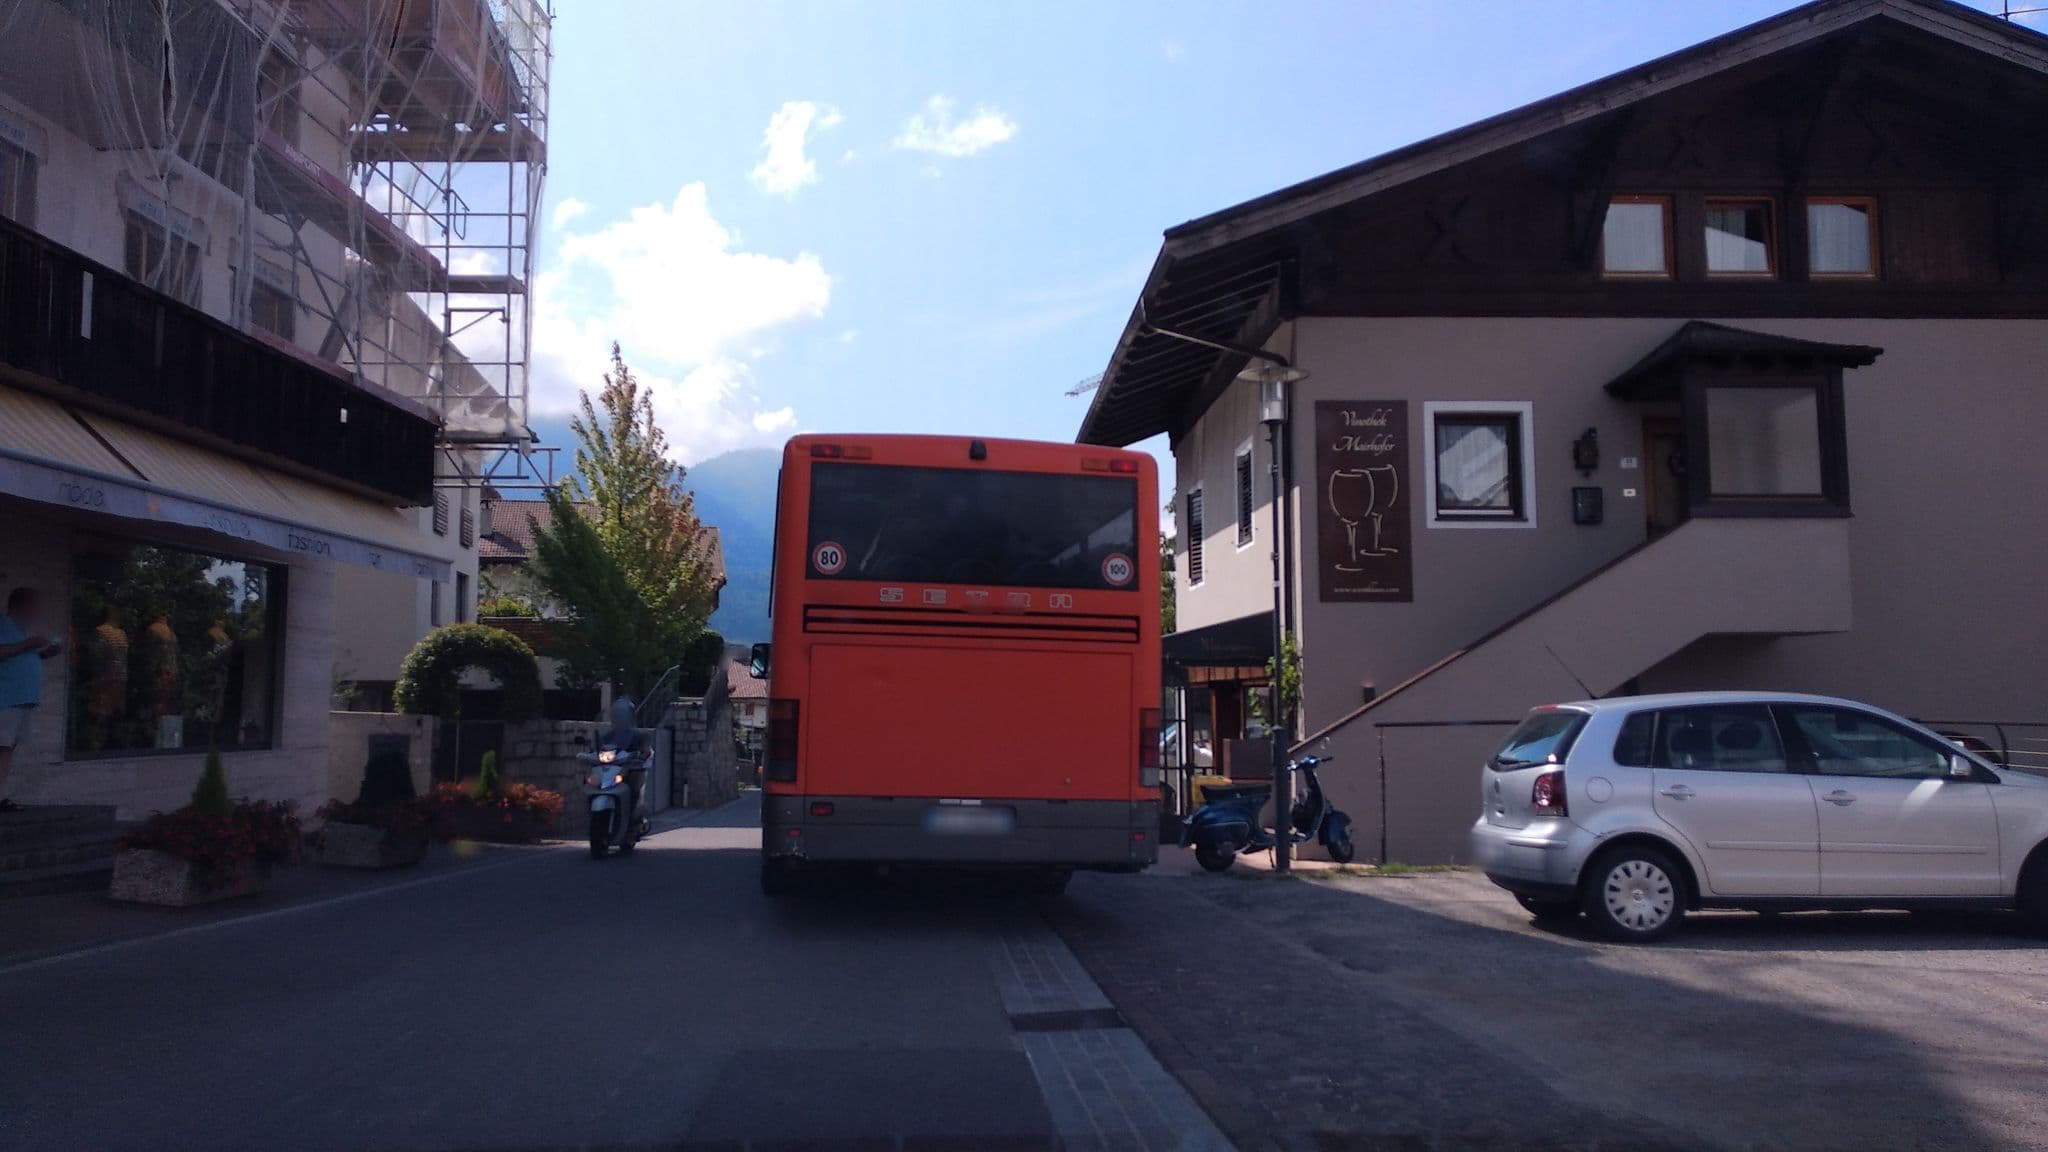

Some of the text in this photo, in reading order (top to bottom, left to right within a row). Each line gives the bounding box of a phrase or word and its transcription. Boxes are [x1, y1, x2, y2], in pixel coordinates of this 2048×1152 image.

[1341, 408, 1393, 426] Vinothek
[820, 550, 839, 566] 80
[1109, 563, 1127, 576] 100
